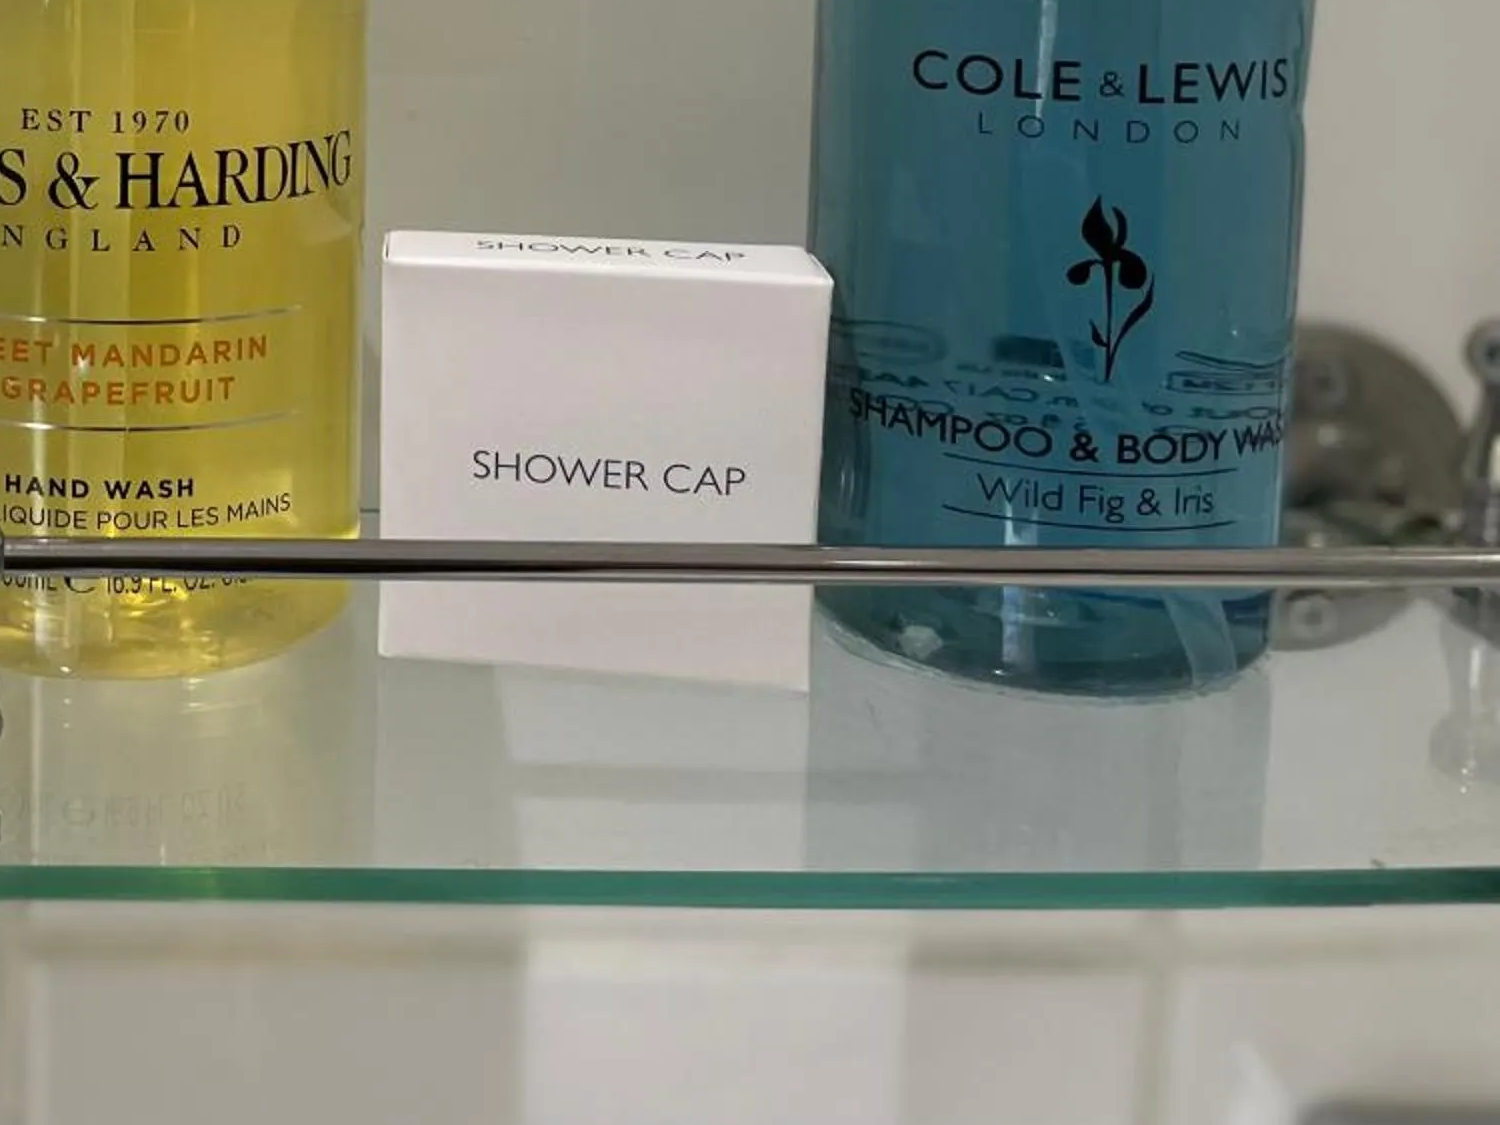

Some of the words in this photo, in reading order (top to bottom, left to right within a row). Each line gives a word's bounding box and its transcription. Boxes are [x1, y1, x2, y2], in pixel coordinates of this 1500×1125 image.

[912, 50, 1082, 102] COLE
[1099, 71, 1126, 97] &
[1138, 58, 1288, 105] LEWIS
[21, 108, 92, 133] EST
[111, 110, 191, 134] 1970
[978, 111, 1241, 144] LONDON
[47, 151, 100, 211] &
[115, 128, 352, 210] HARDING
[476, 239, 652, 259] SHOWER
[663, 248, 746, 263] CAP
[71, 334, 268, 368] MANDARIN
[1, 375, 236, 405] GRAPEFRUIT
[848, 386, 1054, 458] SHAMPOO
[1068, 431, 1100, 463] &
[1116, 429, 1228, 465] BODY
[5, 474, 90, 499] HAND
[104, 477, 195, 501] WASH
[472, 449, 650, 492] SHOWER
[663, 463, 747, 497] CAP
[97, 509, 168, 532] POUR
[177, 505, 219, 529] LES
[227, 491, 292, 524] MAINS
[976, 472, 1064, 513] Wild
[1079, 484, 1125, 523] Fig
[1136, 487, 1162, 517] &
[1174, 484, 1214, 514] Iris
